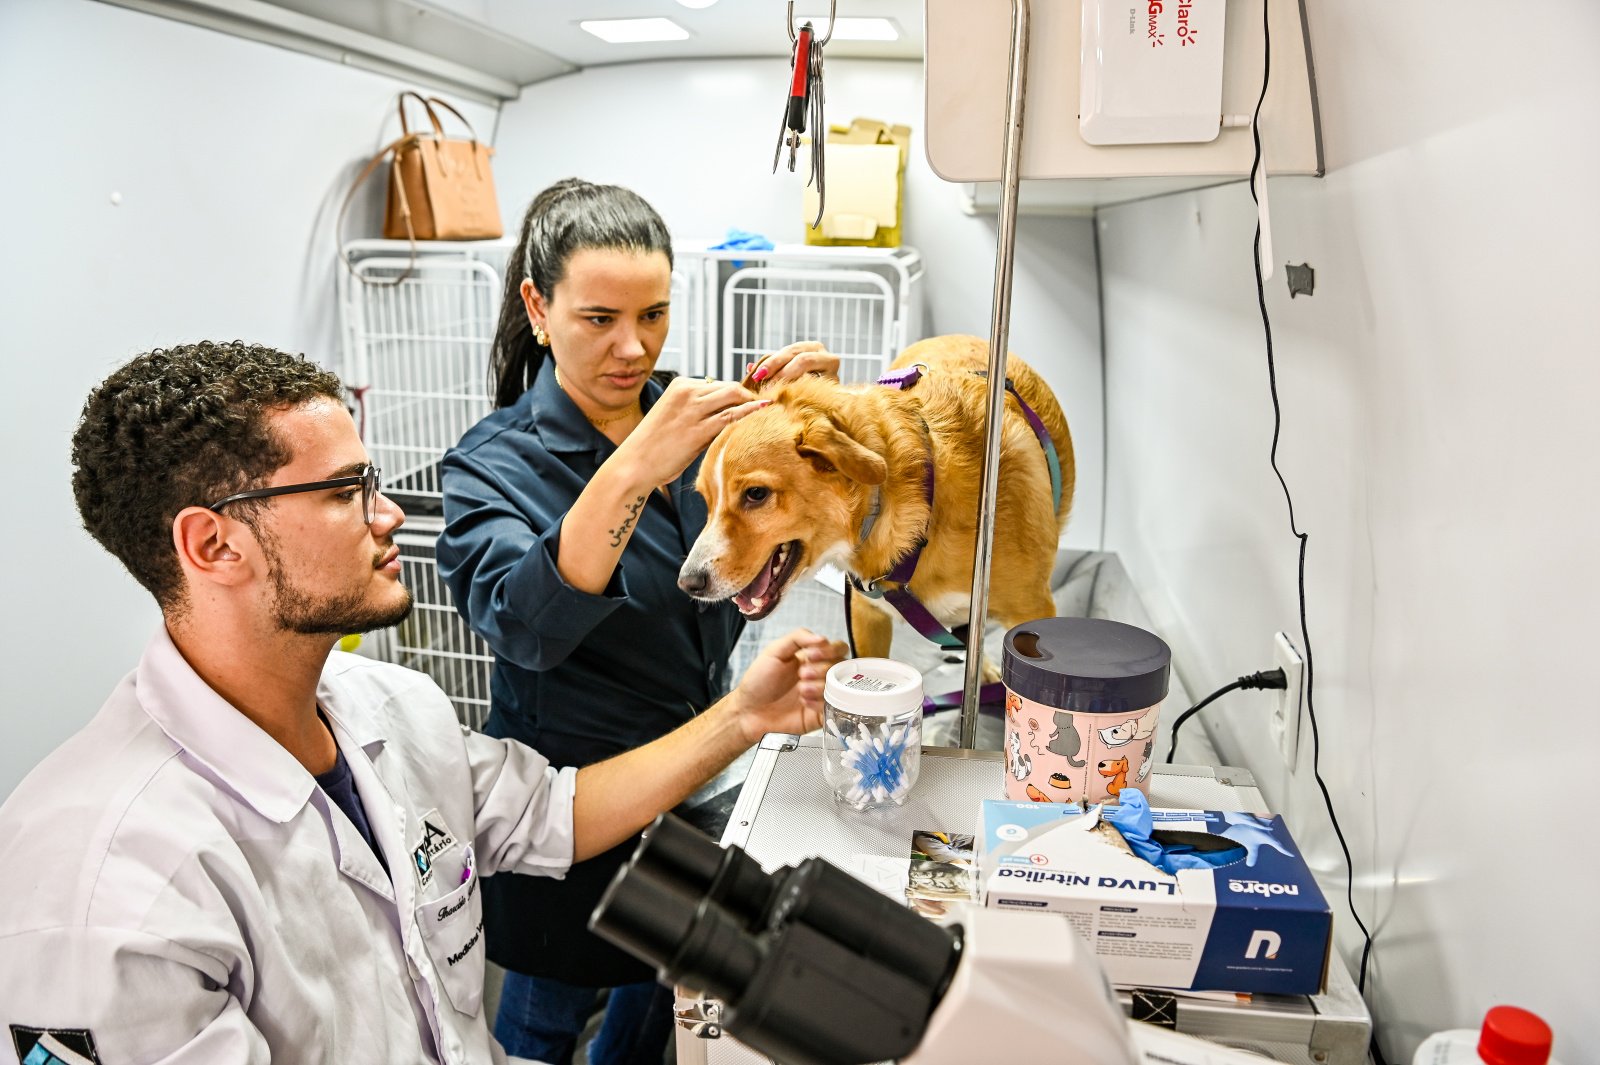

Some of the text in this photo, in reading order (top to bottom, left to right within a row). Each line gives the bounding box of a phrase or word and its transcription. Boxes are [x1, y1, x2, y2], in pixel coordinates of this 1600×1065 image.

[1177, 0, 1192, 37] laro
[998, 868, 1090, 887] Nitrílica
[1098, 876, 1176, 896] Luva
[1228, 882, 1299, 898] nobre
